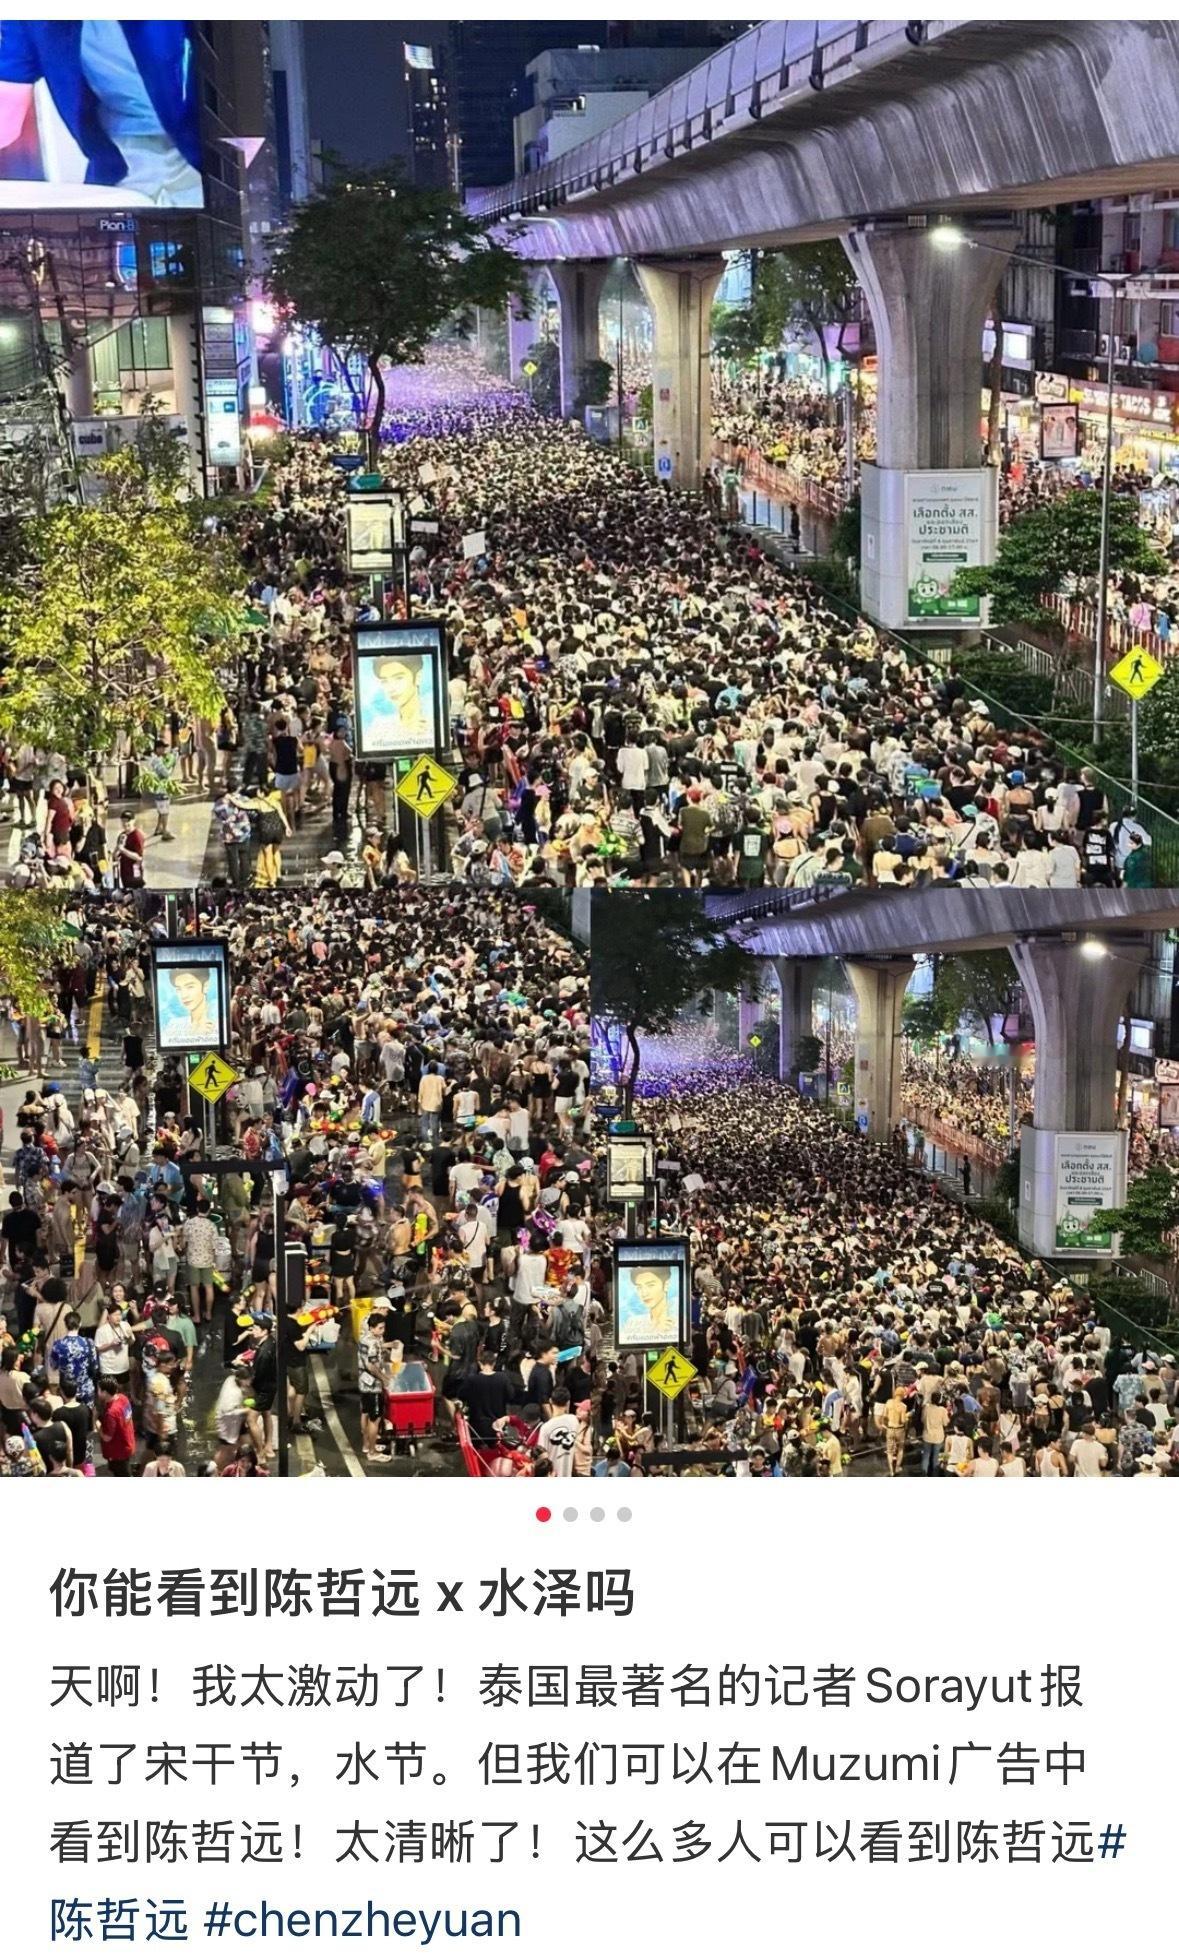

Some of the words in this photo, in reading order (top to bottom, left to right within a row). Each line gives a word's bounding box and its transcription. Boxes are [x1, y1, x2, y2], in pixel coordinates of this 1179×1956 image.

[913, 503, 955, 518] เลือกตั้ง
[959, 508, 978, 518] สส.
[918, 523, 969, 535] ประชามติ
[1061, 1158, 1094, 1170] เลือกตั้ง
[1065, 1174, 1104, 1183] ประชามติ
